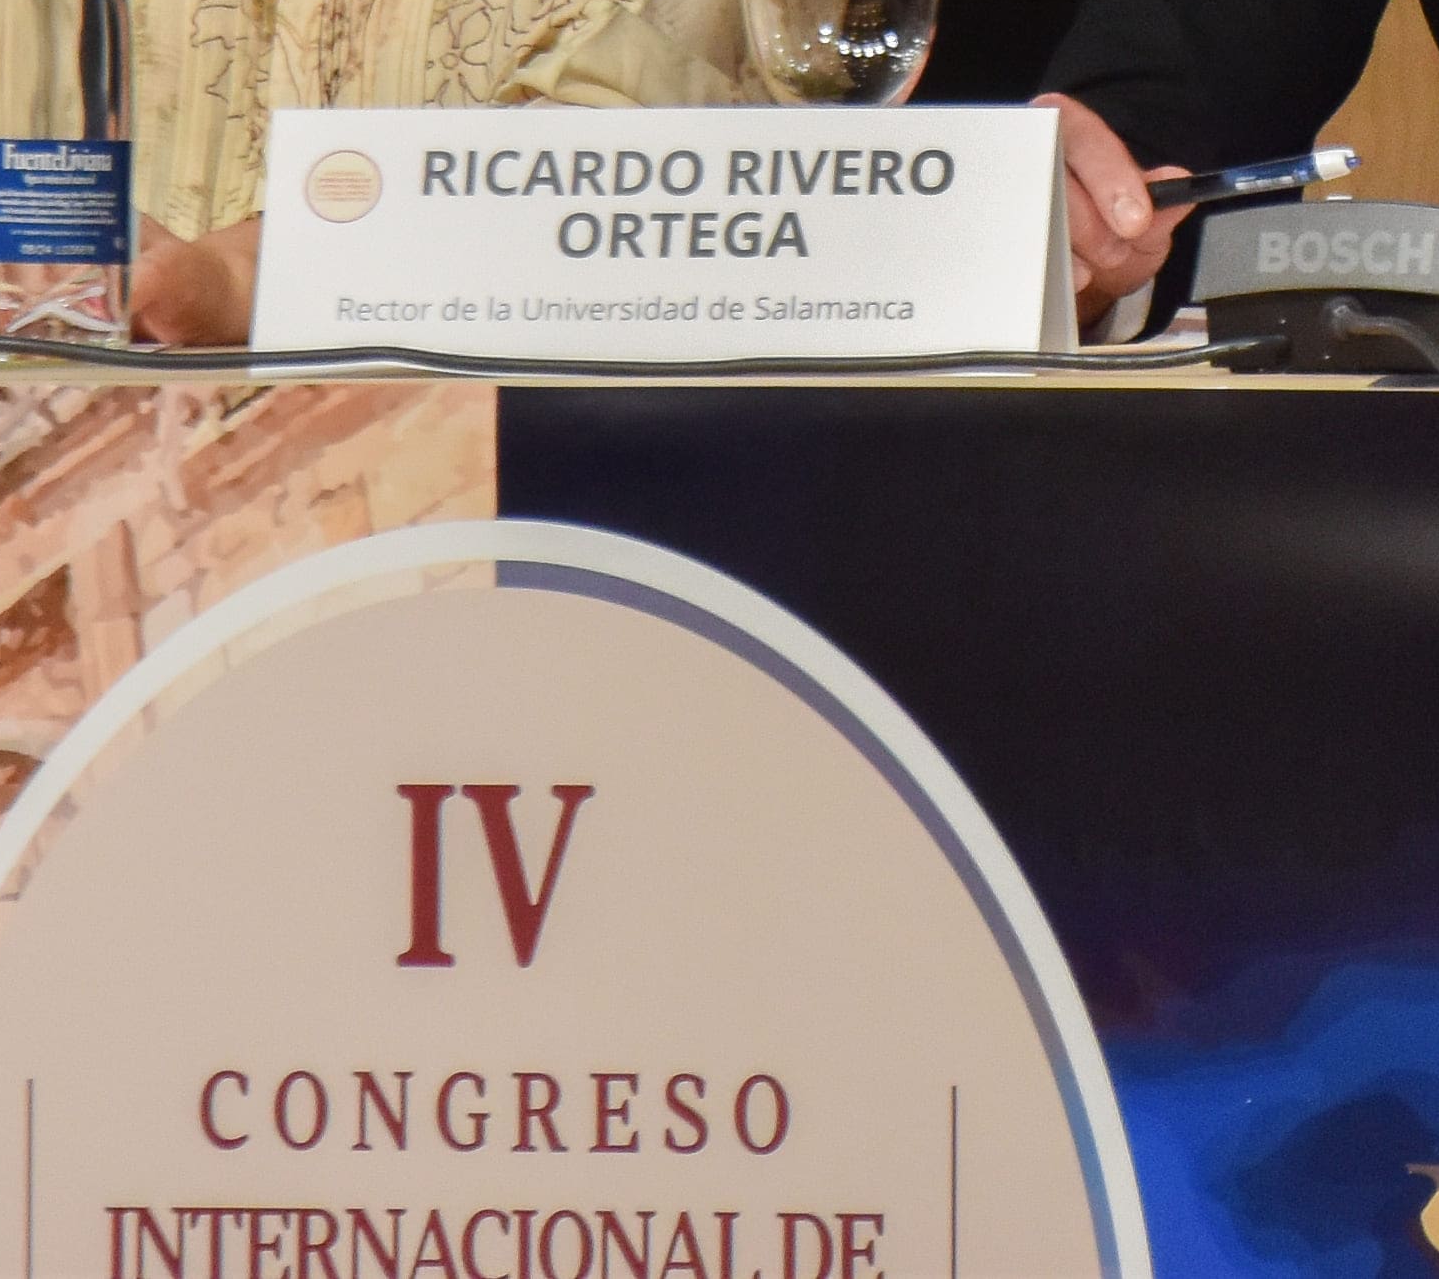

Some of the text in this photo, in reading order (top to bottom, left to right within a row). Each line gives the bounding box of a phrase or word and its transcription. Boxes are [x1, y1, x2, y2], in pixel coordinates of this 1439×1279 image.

[422, 149, 704, 196] RICARDO
[727, 149, 955, 196] RIVERO
[557, 211, 809, 259] ORTEGA
[1257, 230, 1434, 275] BOSCH
[337, 294, 915, 322] Rector de la Universidad de Salamanca
[397, 783, 595, 968] IV
[199, 1070, 791, 1153] CONGRESO
[106, 1206, 886, 1279] INTERNACIONAL DE
